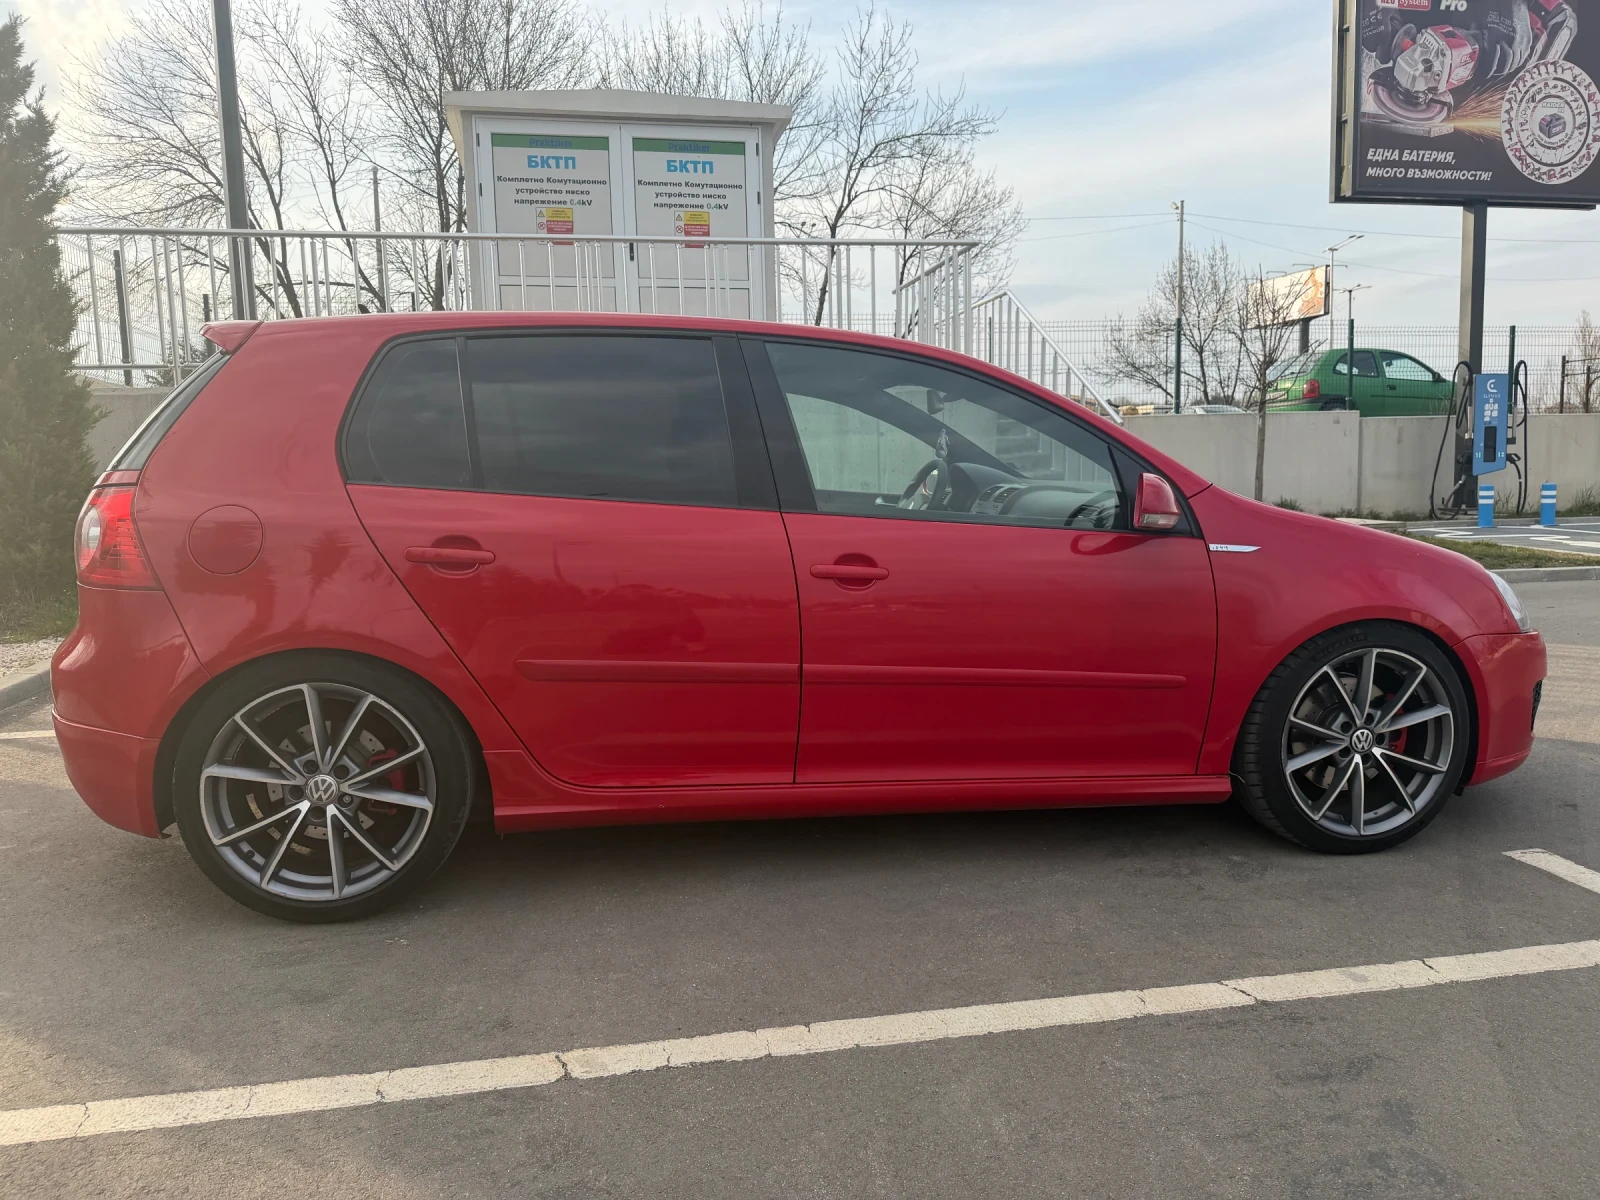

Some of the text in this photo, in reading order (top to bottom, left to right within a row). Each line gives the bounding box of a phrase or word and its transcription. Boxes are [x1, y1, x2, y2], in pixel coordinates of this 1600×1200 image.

[1440, 0, 1468, 11] Pro
[529, 138, 573, 148] Praktiker
[668, 143, 711, 152] Praktiker
[1367, 148, 1456, 164] ЕДНА БАТЕРИЯ,
[527, 155, 576, 169] БКТП
[666, 159, 714, 174] БКТП
[1366, 167, 1493, 181] МНОГО ВЪЗМОЖНОСТИ!
[497, 175, 607, 185] Комплетно Комутационно
[637, 179, 743, 189] Комплетно Комутационно
[515, 187, 563, 195] устройство
[655, 191, 701, 199] устройство
[514, 198, 568, 206] напрежение
[307, 774, 338, 804] VW
